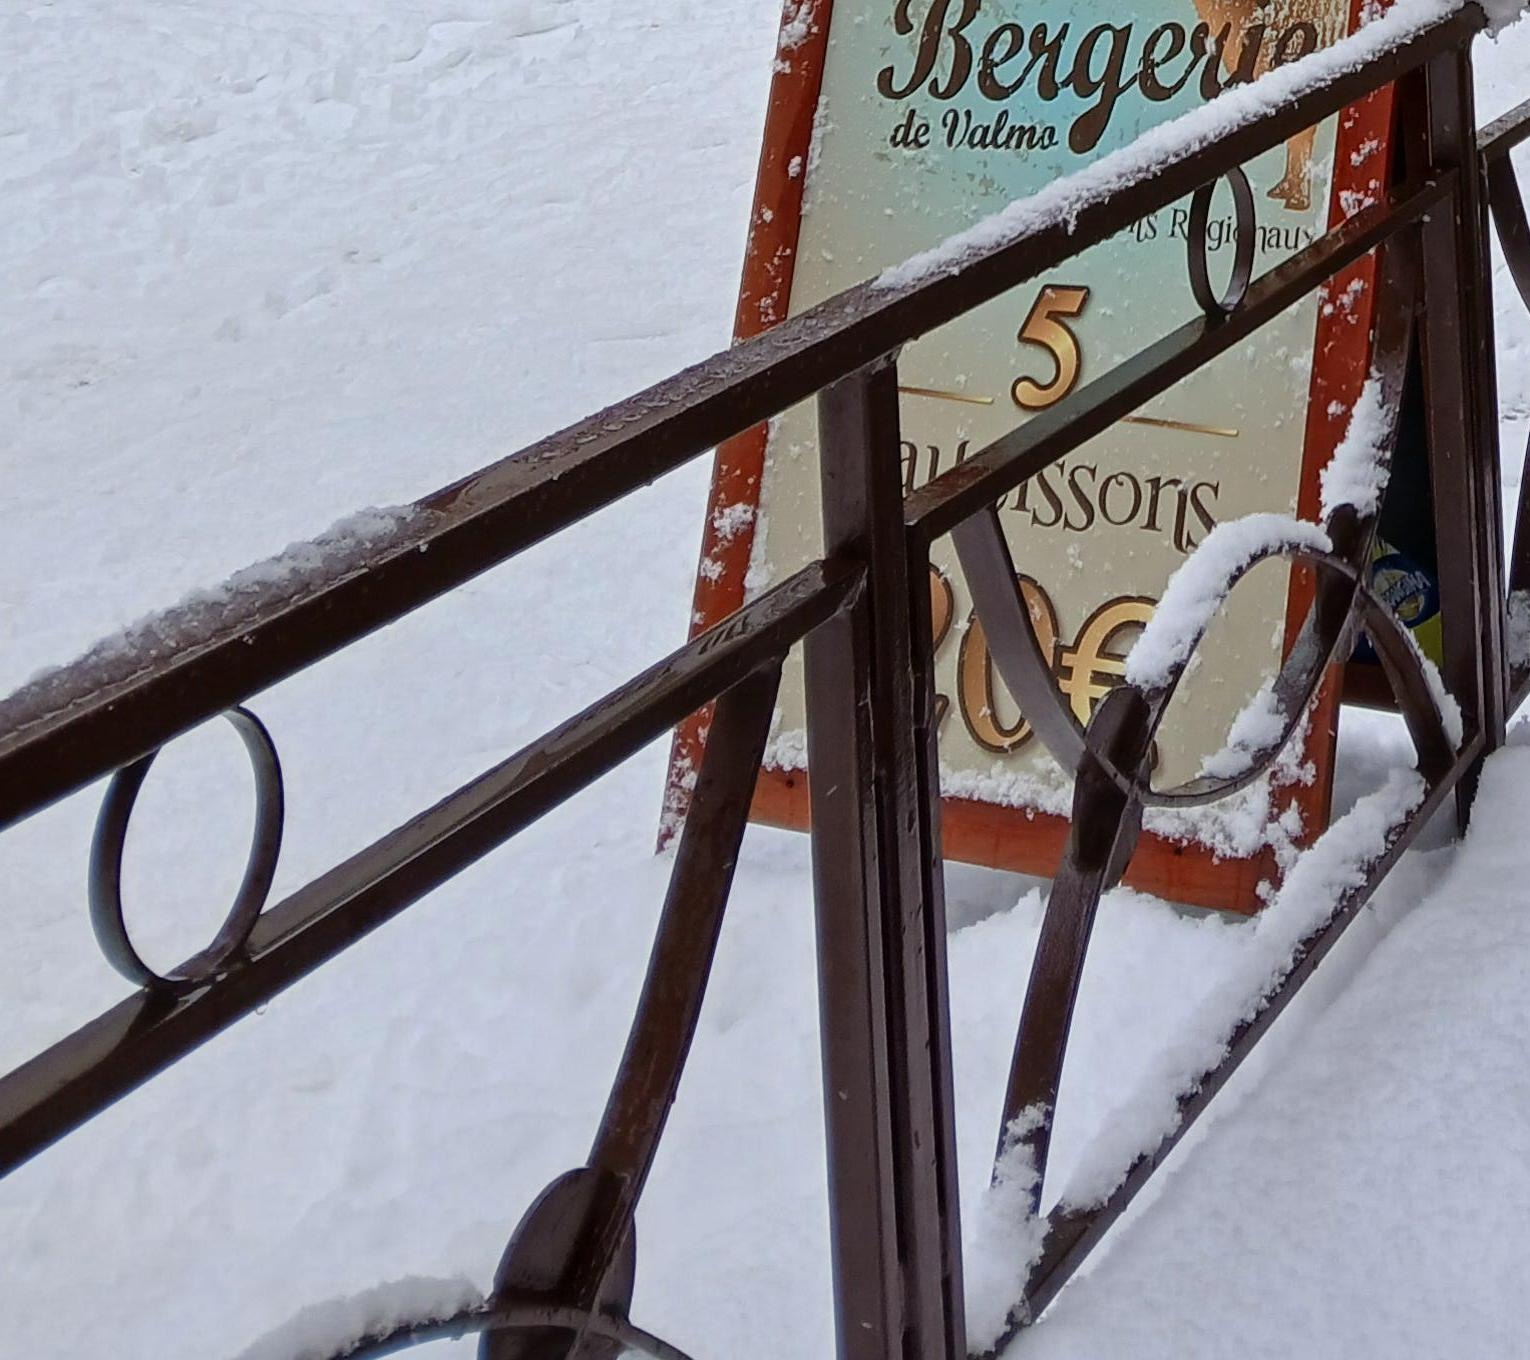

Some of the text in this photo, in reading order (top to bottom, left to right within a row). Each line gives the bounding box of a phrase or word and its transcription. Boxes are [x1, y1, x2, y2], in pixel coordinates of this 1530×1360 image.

[889, 108, 1060, 152] de Valmo
[1011, 284, 1090, 412] 5
